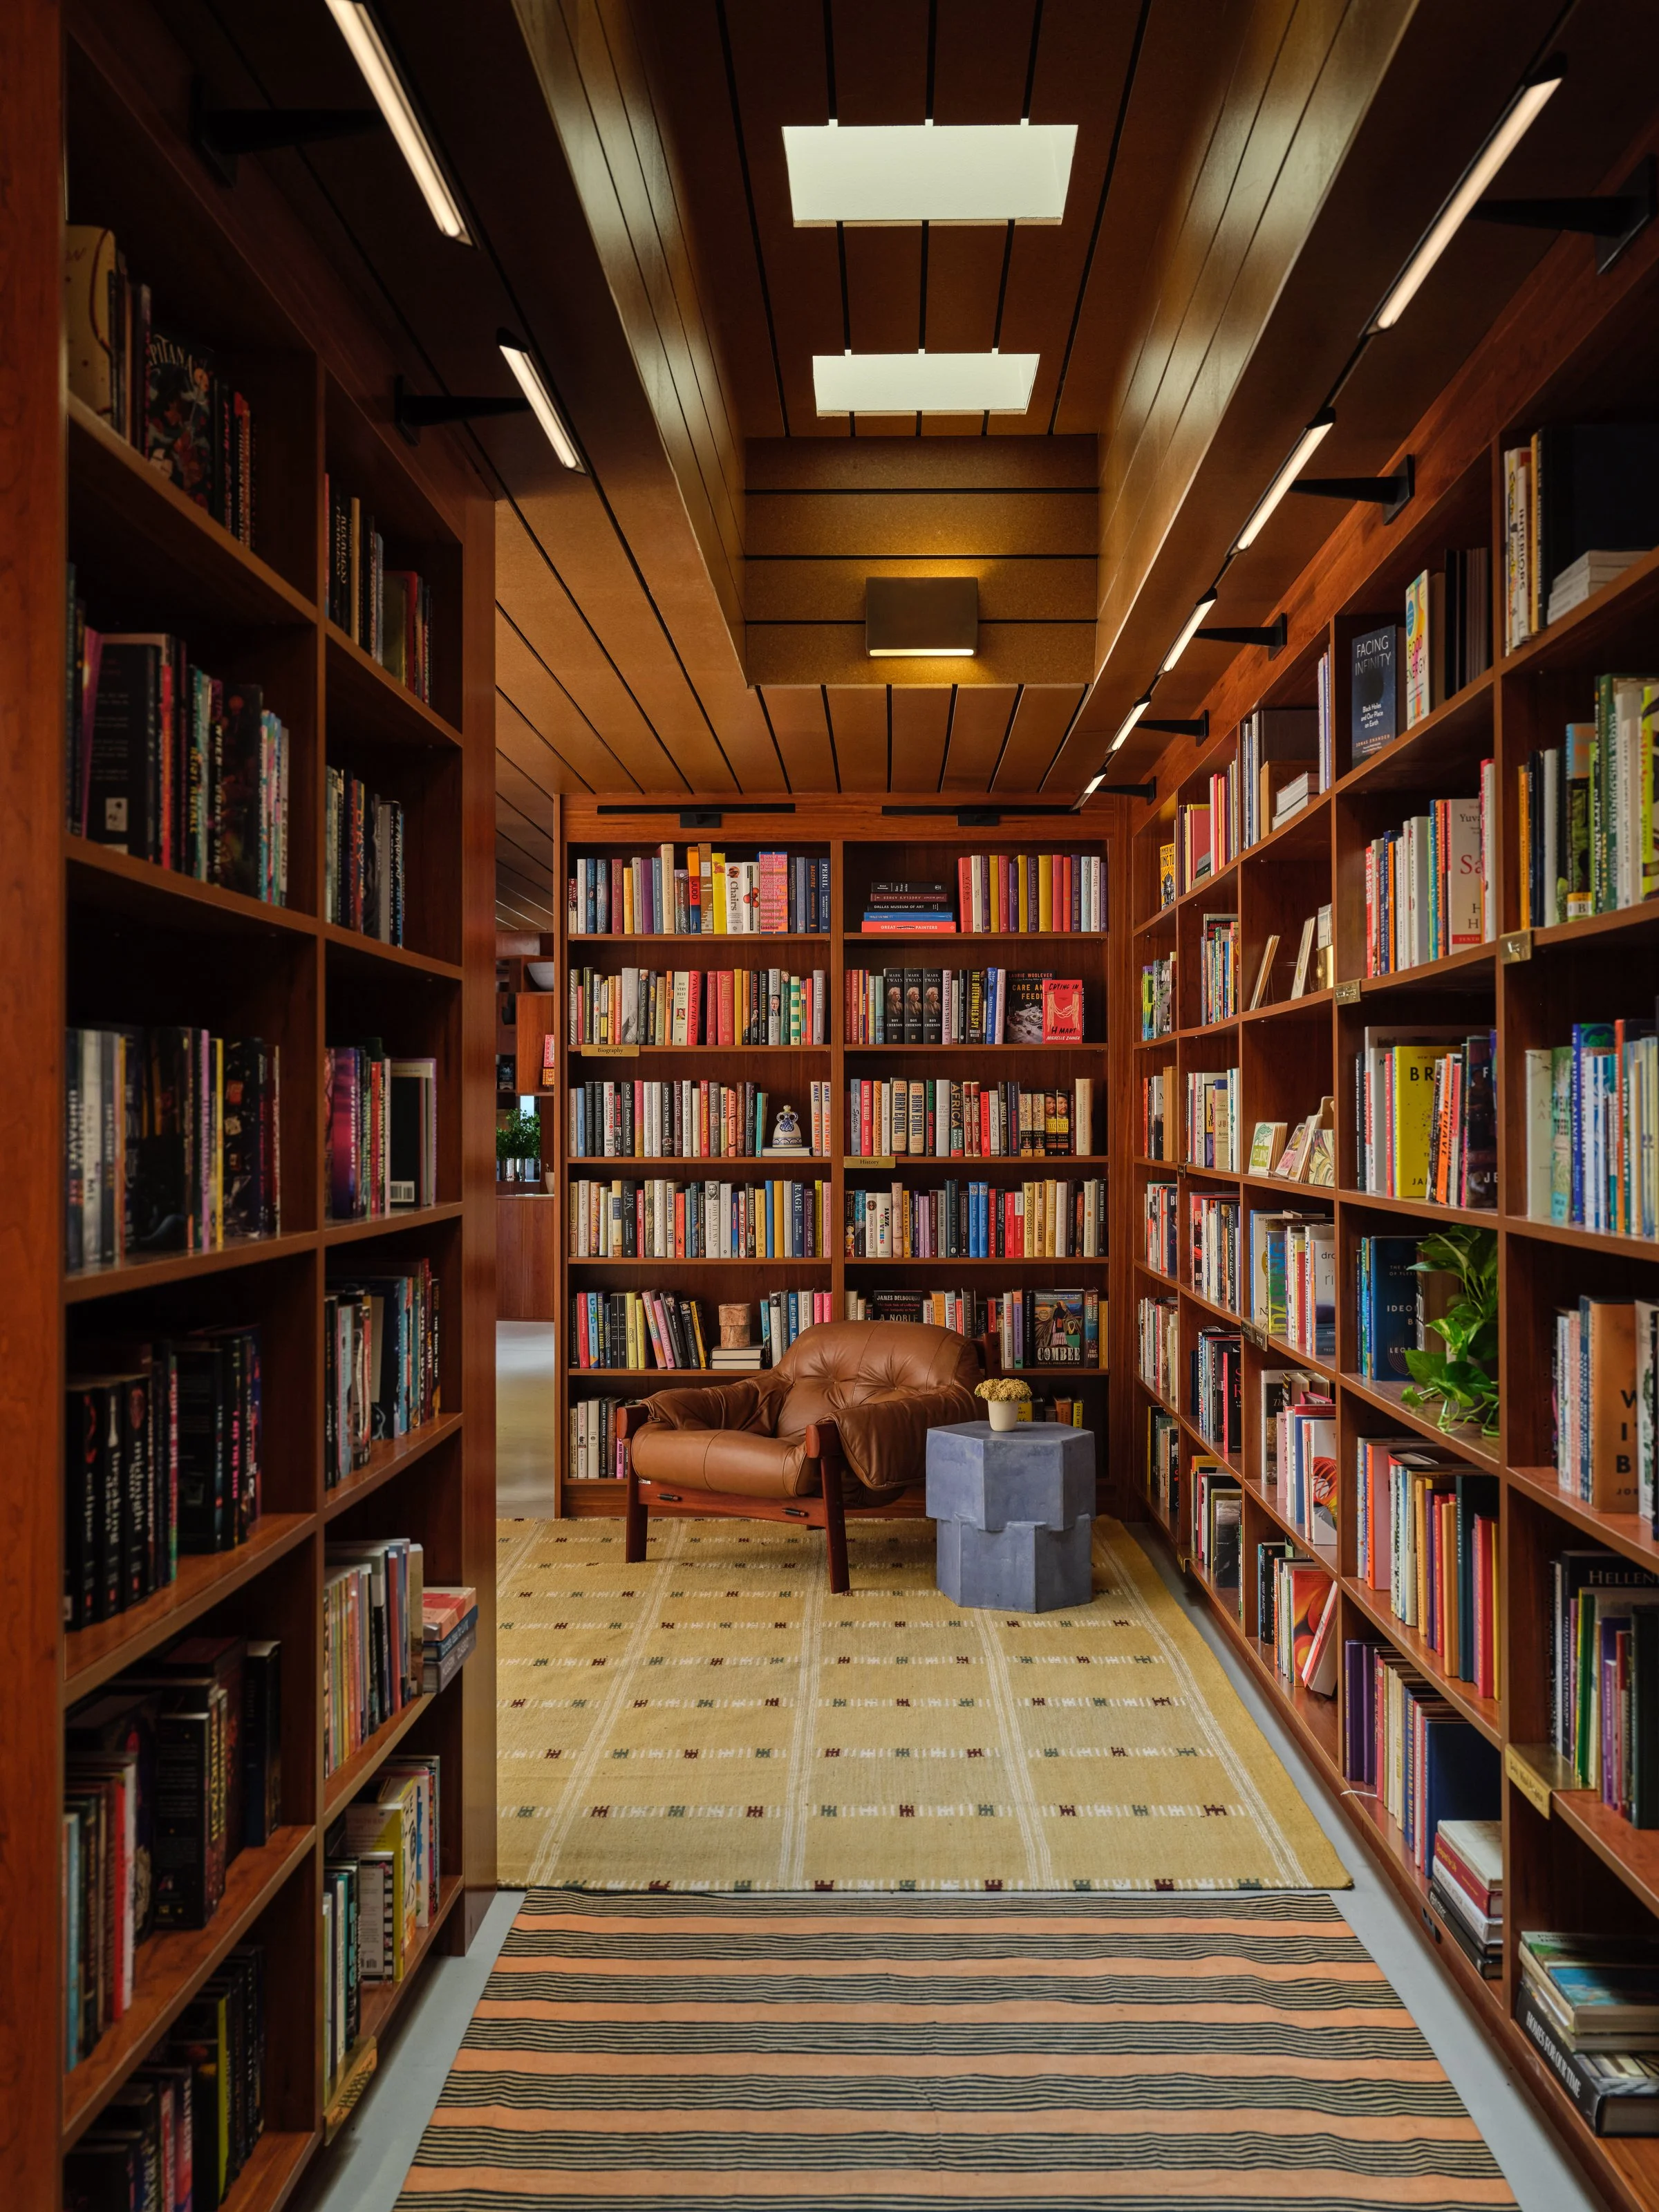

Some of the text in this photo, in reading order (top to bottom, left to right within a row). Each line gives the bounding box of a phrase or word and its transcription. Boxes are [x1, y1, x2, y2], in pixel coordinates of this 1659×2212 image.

[1357, 635, 1389, 659] FACING
[1408, 635, 1423, 659] GOOD
[1356, 652, 1391, 676] INFINITY
[1406, 655, 1425, 685] ENERGY
[730, 881, 738, 911] Chairs
[1051, 1026, 1058, 1034] H
[895, 1093, 906, 1114] BORN
[912, 1095, 922, 1114] BORN
[952, 1084, 960, 1128] AFRICA
[893, 1116, 906, 1134] EQUAL
[910, 1116, 922, 1136] EQUAL
[1440, 1100, 1450, 1156] BEHAVE
[1037, 1348, 1080, 1360] COMBEE
[84, 1472, 95, 1543] eclipse
[1589, 1570, 1659, 1584] HELLEN
[1526, 2010, 1582, 2099] HOMES FOR OUR TIME
